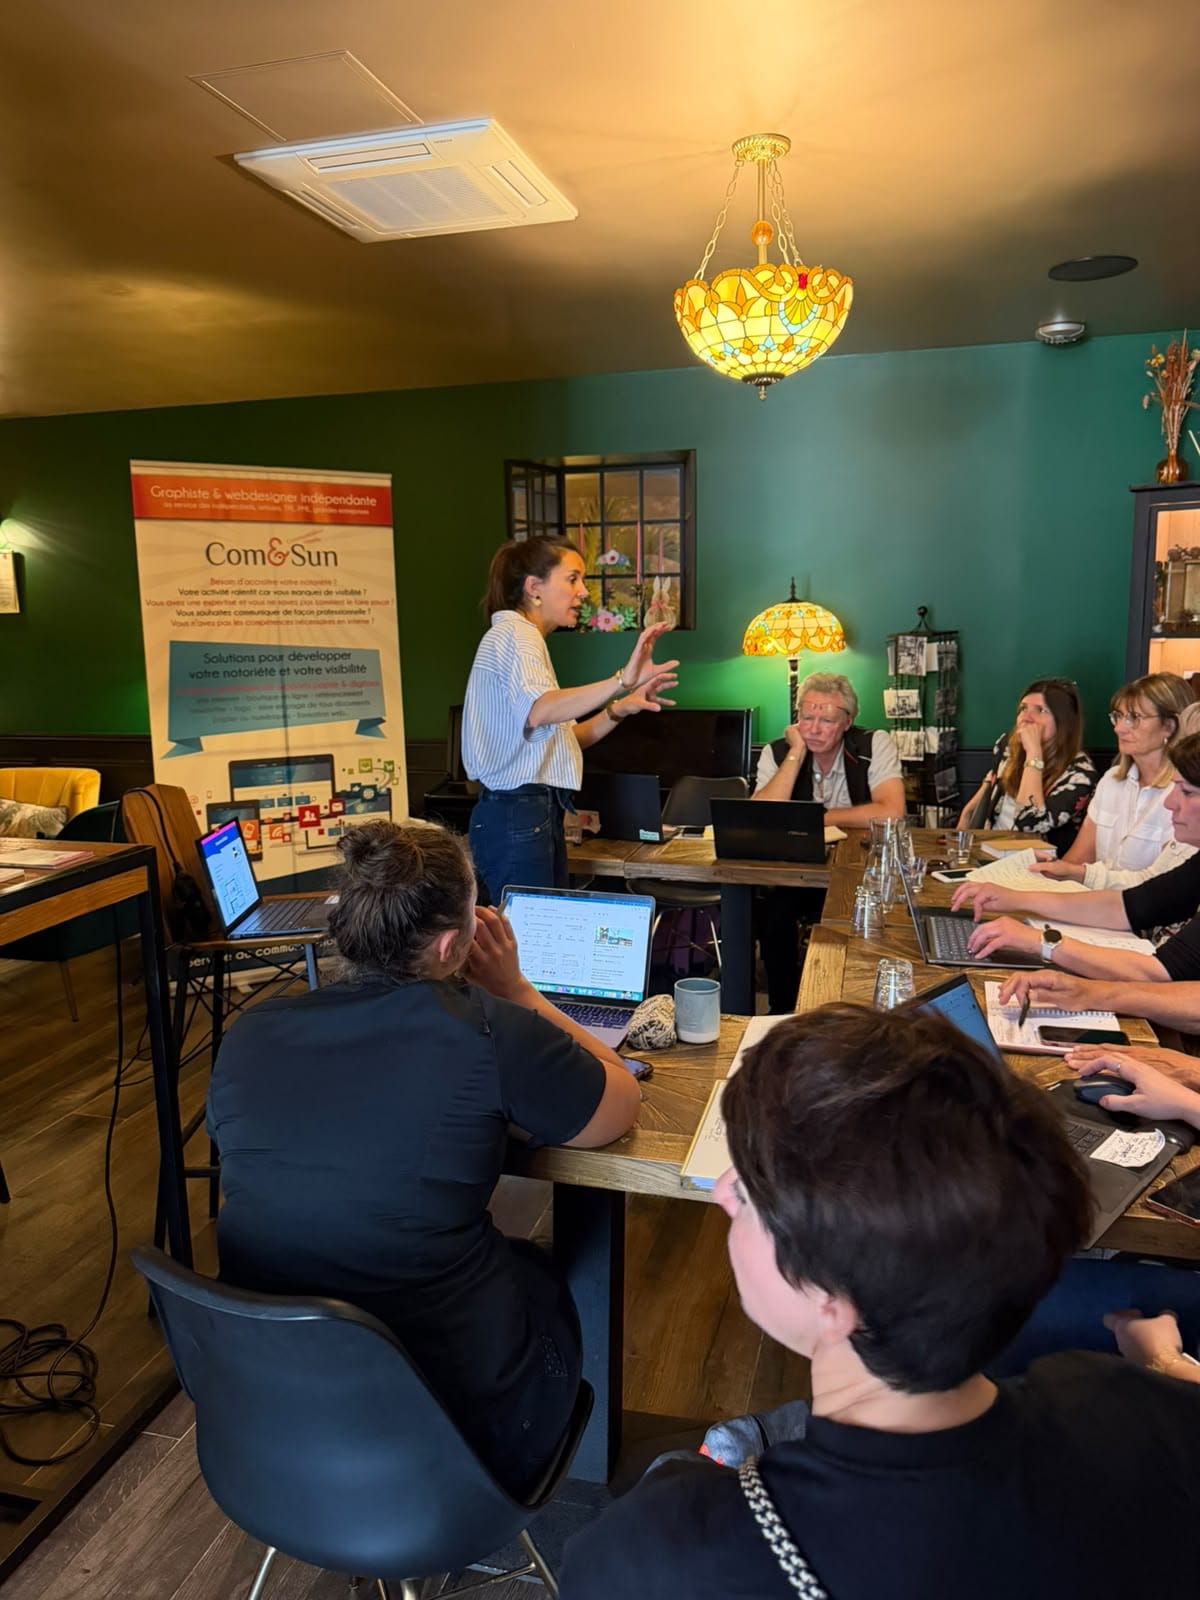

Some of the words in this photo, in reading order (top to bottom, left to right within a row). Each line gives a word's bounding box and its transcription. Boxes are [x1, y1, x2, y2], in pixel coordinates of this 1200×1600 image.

[151, 485, 209, 500] Graphiste
[212, 488, 221, 499] &
[224, 489, 297, 504] webdesigner
[301, 492, 377, 507] indépendante
[205, 537, 338, 568] Com&Sun
[210, 577, 235, 586] Besoin
[178, 588, 199, 596] Votre
[201, 588, 229, 596] activité
[324, 588, 333, 596] de
[145, 599, 164, 607] Vous
[176, 609, 194, 617] Vous
[282, 608, 292, 616] de
[294, 608, 315, 618] façon
[203, 652, 255, 664] Solutions
[258, 653, 284, 664] pour
[288, 650, 352, 664] développer
[189, 669, 219, 679] votre
[223, 666, 276, 679] notoriété
[280, 666, 290, 677] et
[294, 665, 322, 676] votre
[325, 663, 367, 675] visibilité
